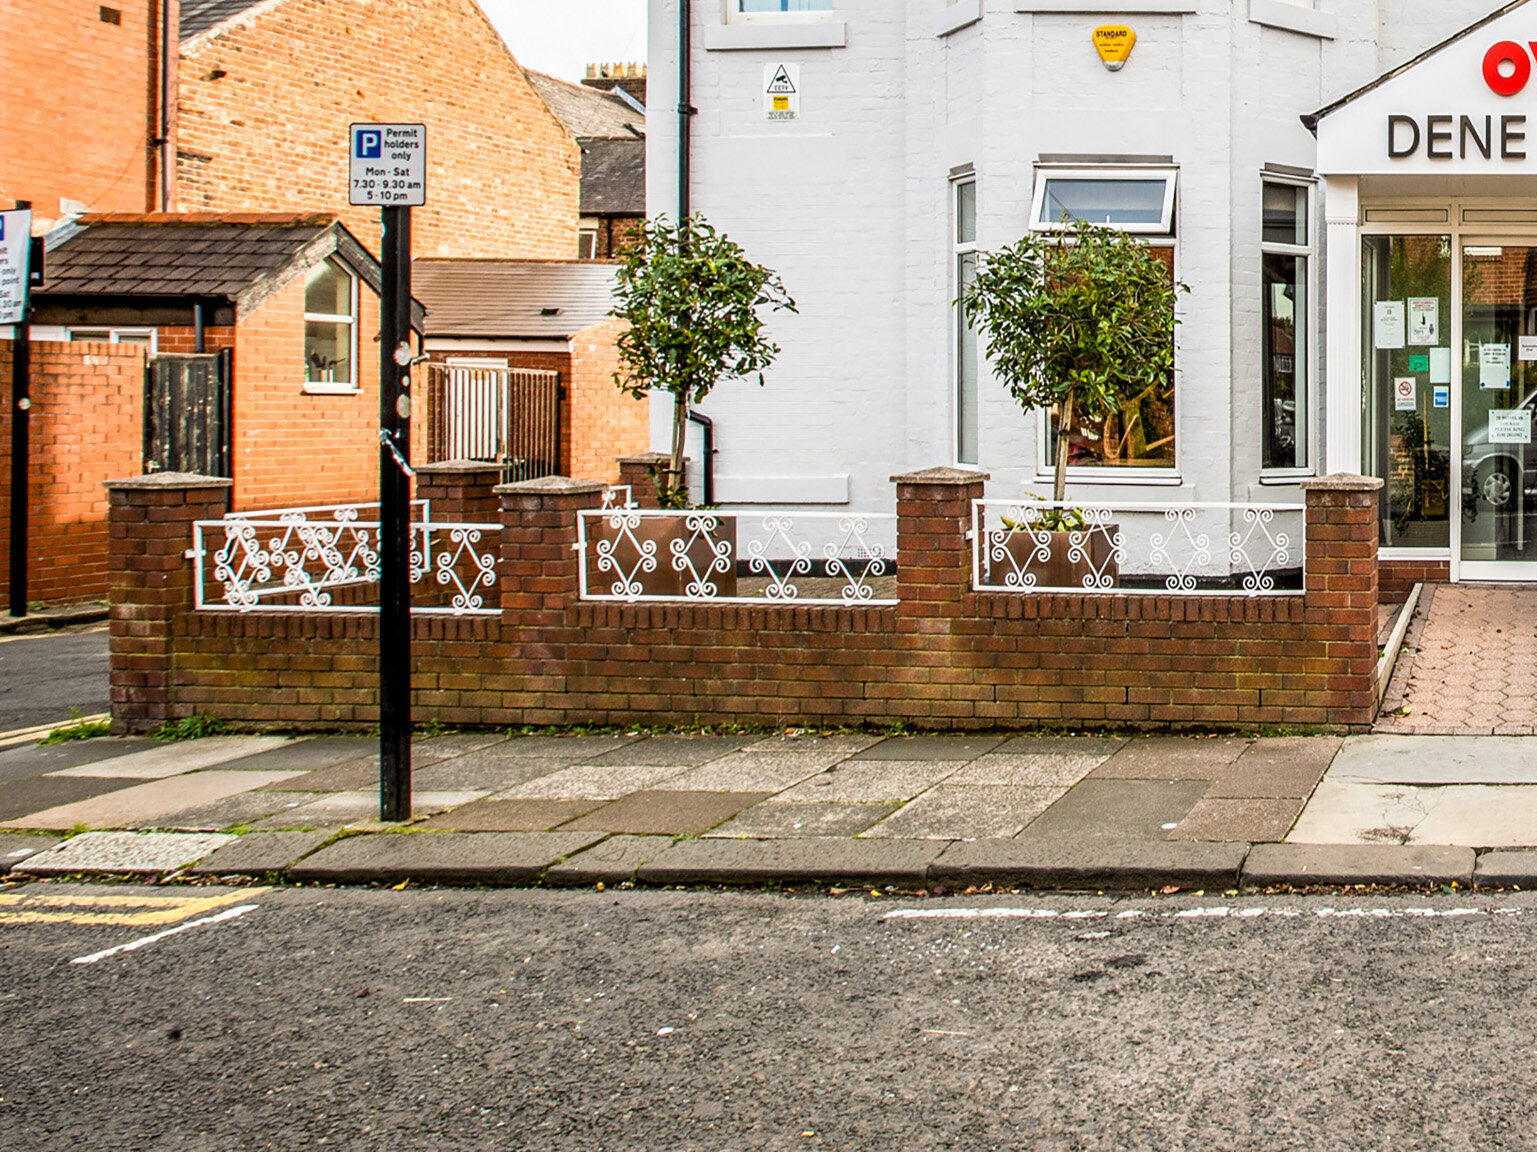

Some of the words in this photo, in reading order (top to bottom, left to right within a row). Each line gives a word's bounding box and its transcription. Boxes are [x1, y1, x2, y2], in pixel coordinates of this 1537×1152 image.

[386, 129, 418, 138] Permit
[1387, 114, 1527, 161] DENE
[362, 133, 378, 156] P
[384, 140, 419, 149] holders
[391, 151, 412, 161] only
[365, 167, 386, 177] Mon
[393, 167, 410, 177] Sat
[353, 179, 376, 189] 7.30
[382, 179, 406, 189] 9.30
[407, 181, 421, 189] am
[367, 191, 373, 200] 5
[380, 191, 392, 200] 10
[393, 193, 408, 201] pm
